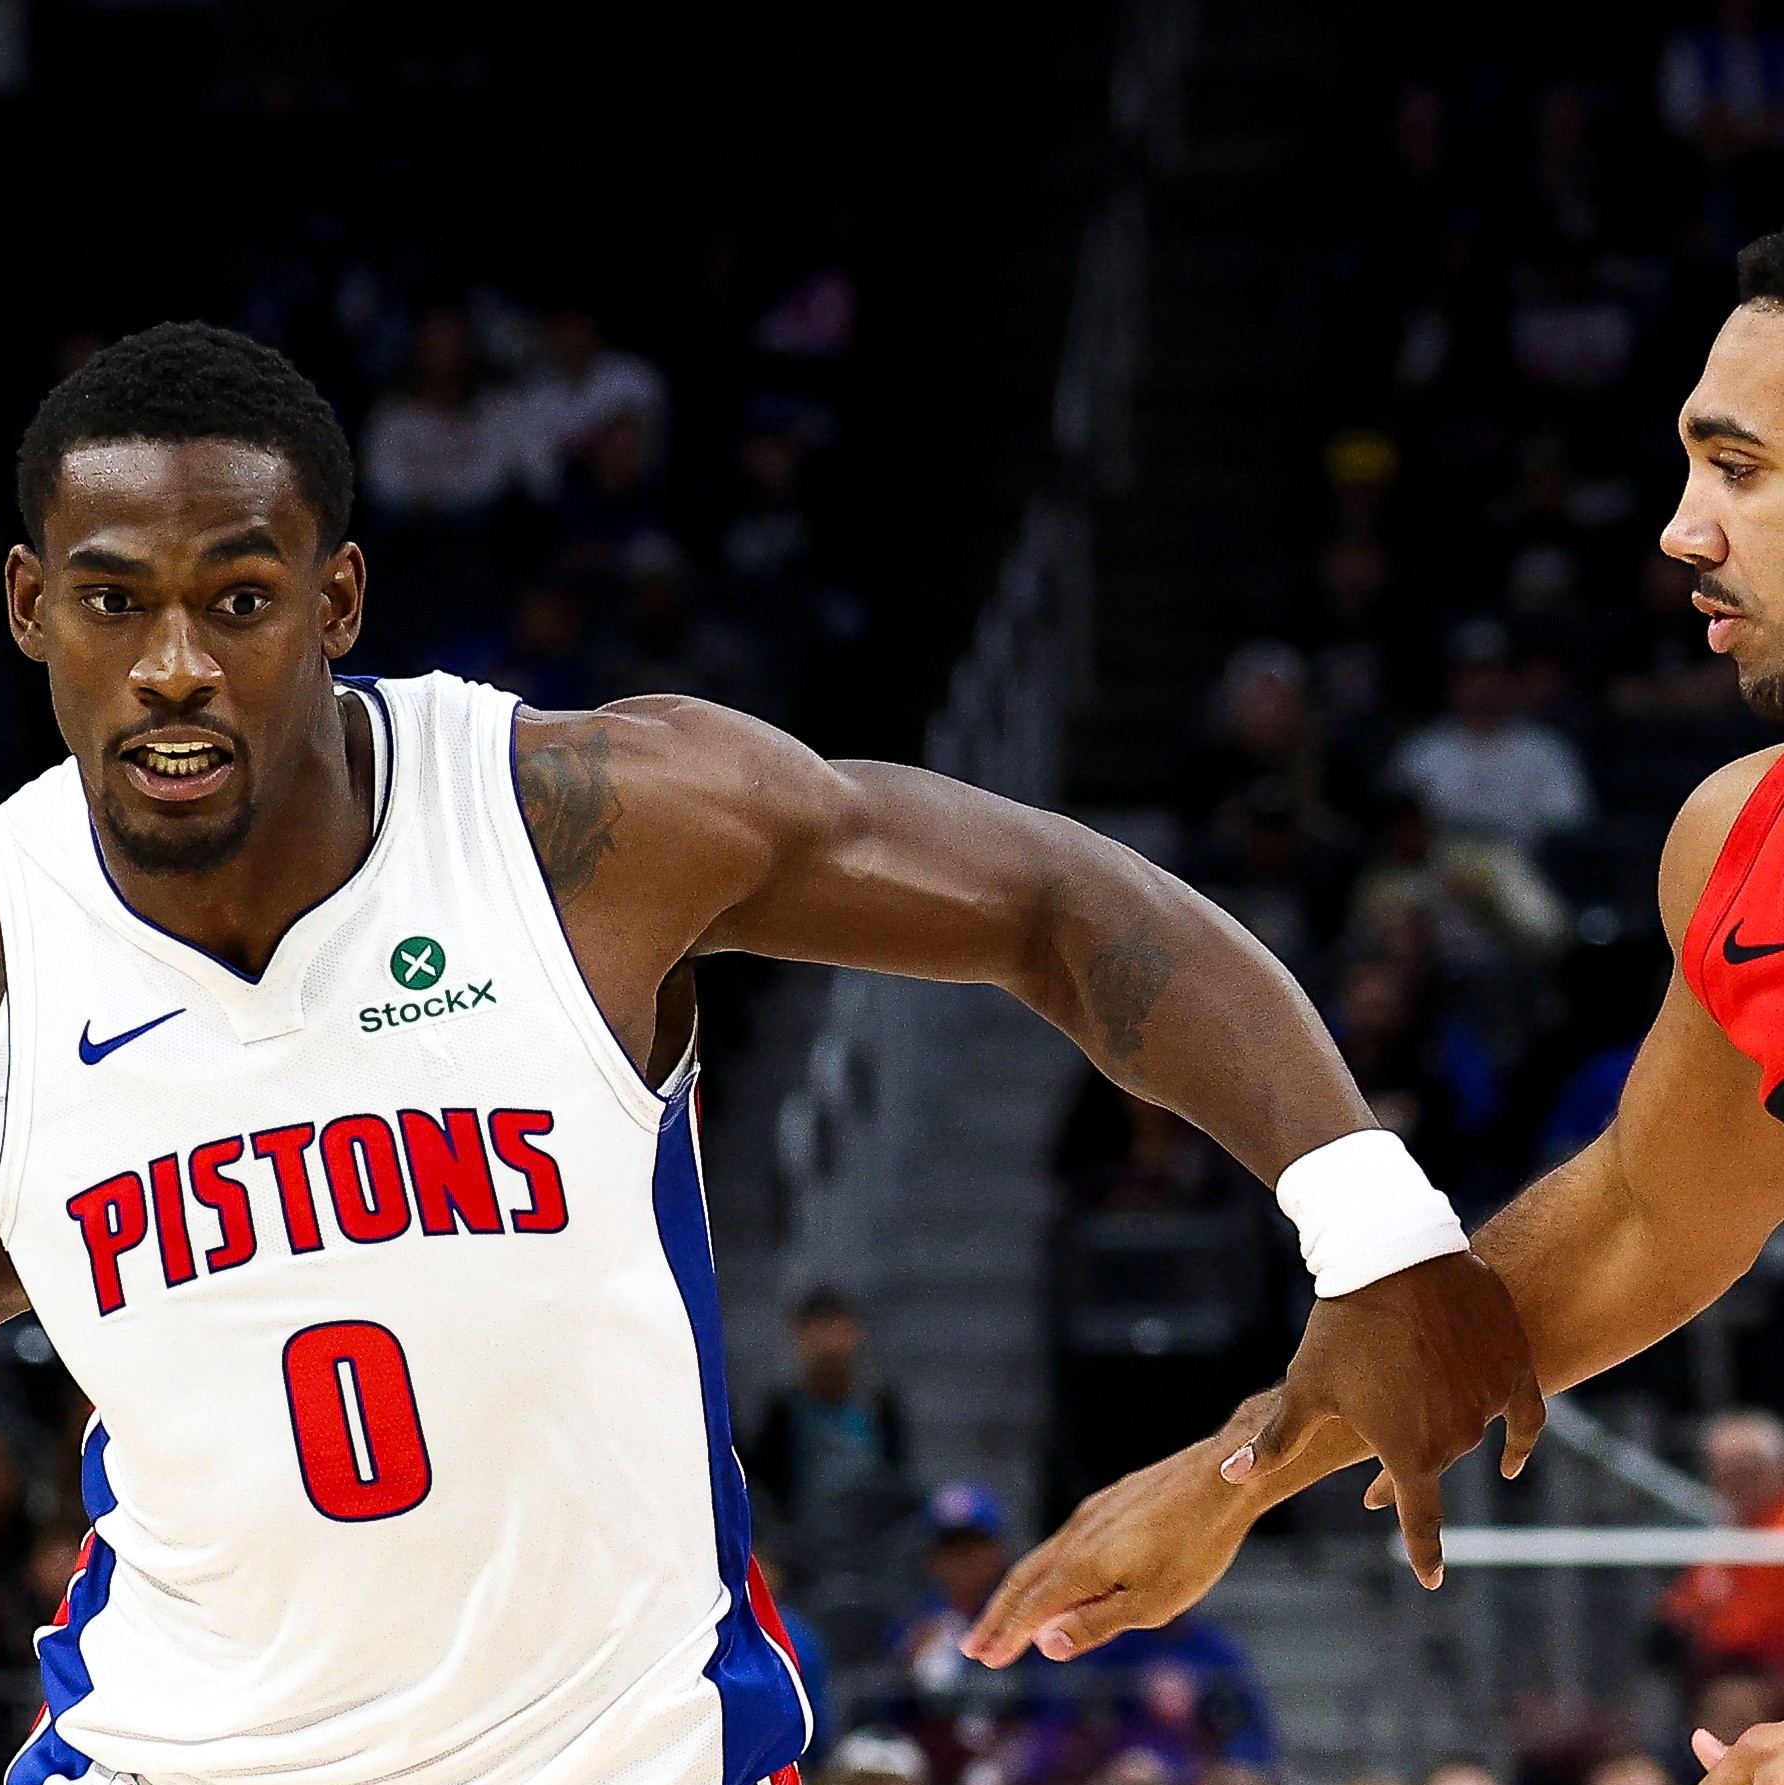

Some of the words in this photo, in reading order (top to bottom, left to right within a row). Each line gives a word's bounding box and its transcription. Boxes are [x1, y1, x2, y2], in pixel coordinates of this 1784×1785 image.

[358, 978, 497, 1034] StockX
[66, 1107, 570, 1318] PISTONS
[281, 1319, 433, 1523] 0
